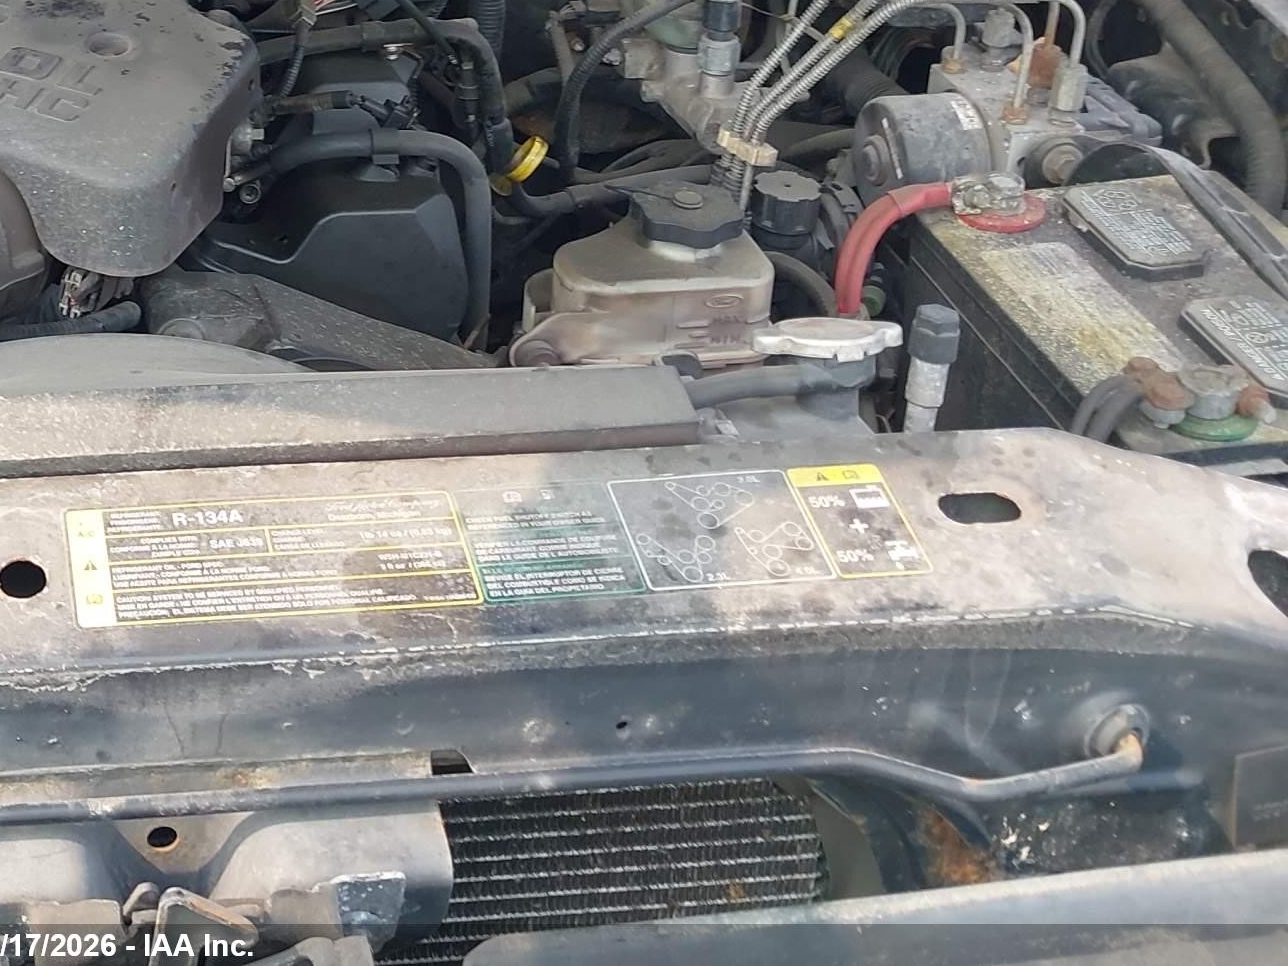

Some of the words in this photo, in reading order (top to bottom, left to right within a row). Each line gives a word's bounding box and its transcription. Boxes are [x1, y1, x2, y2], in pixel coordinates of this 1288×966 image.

[808, 494, 846, 509] 50%
[172, 509, 244, 527] R-134A
[209, 538, 234, 549] SAE
[836, 550, 874, 564] 50%
